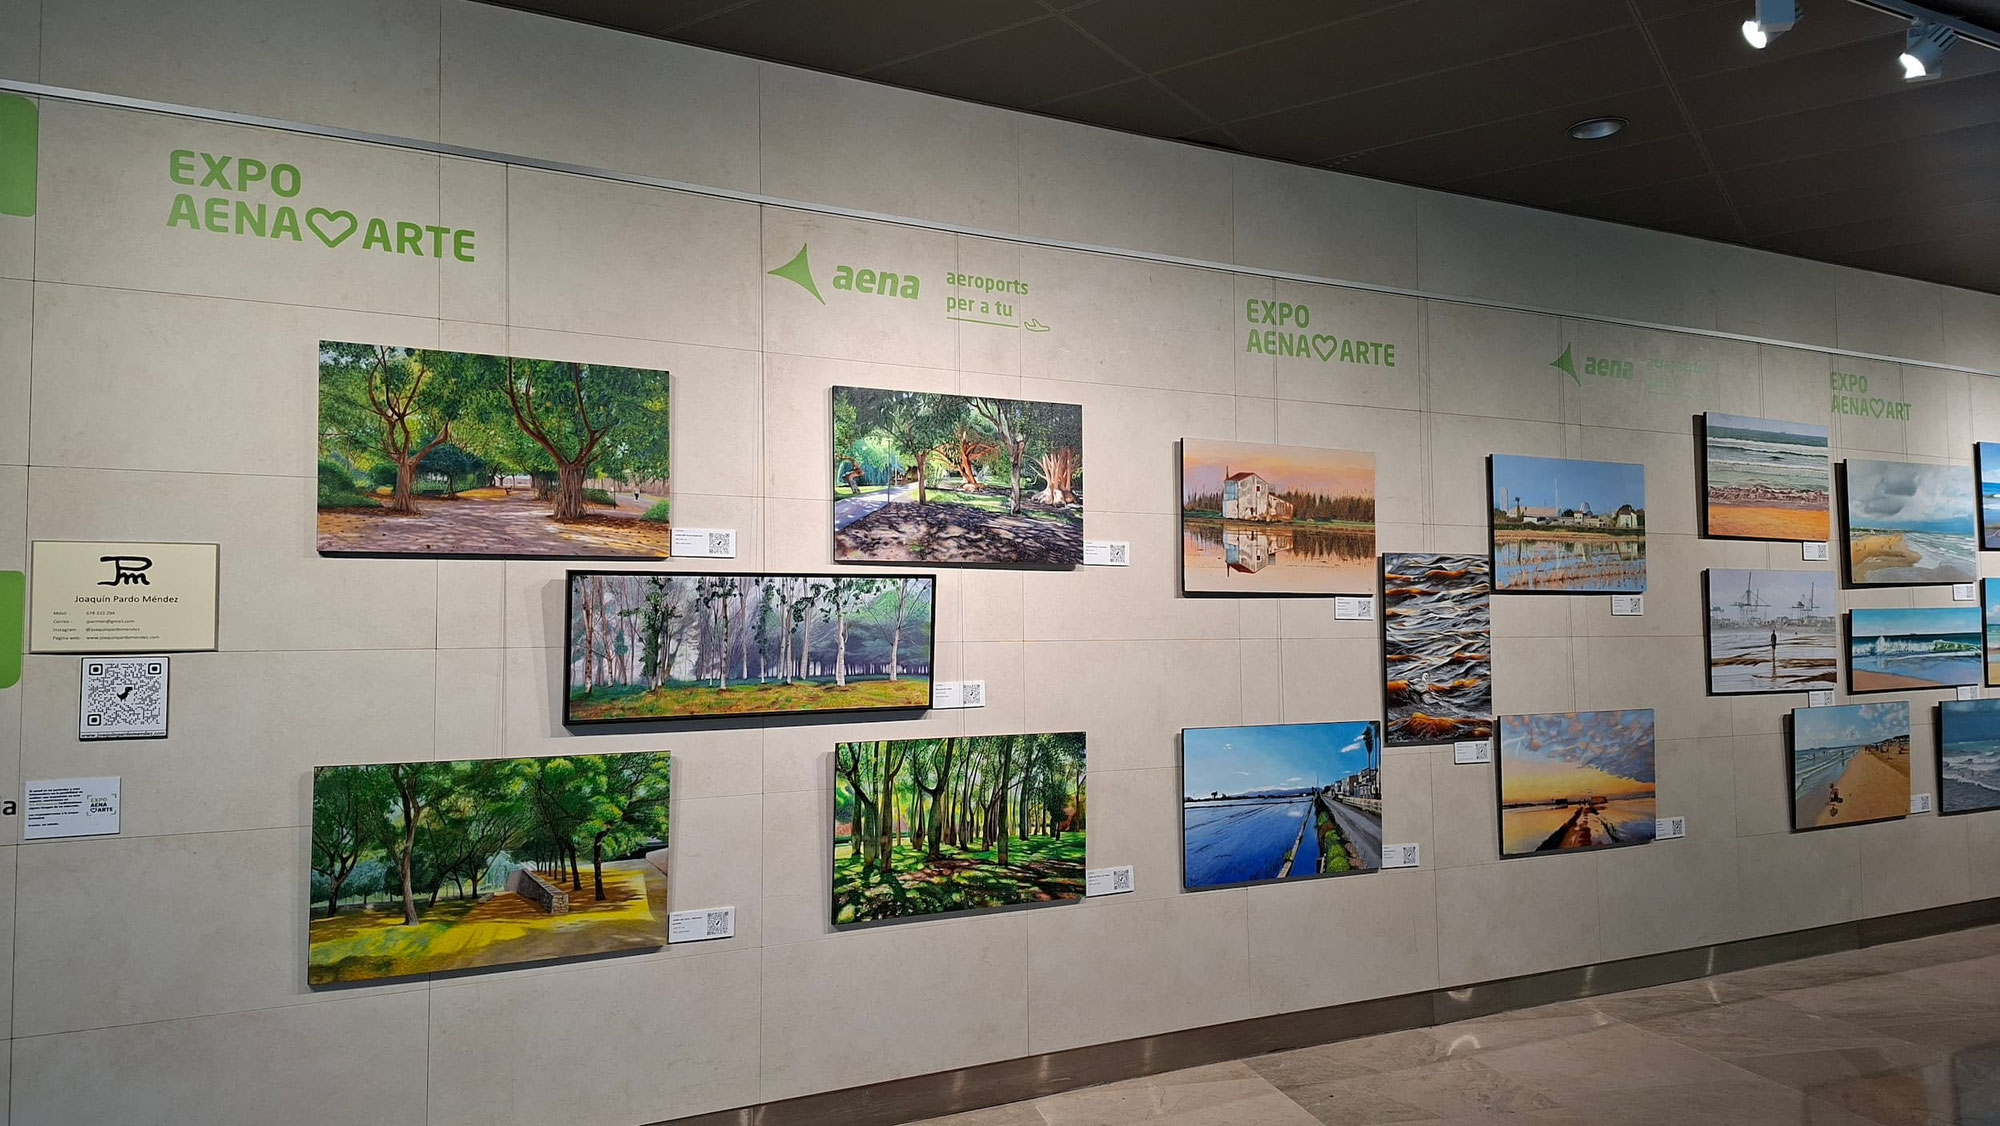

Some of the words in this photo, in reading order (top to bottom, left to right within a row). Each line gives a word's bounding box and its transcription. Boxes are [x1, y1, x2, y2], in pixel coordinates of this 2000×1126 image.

[169, 149, 302, 198] EXPO
[166, 193, 303, 242] AENA
[362, 218, 475, 263] ARTE
[832, 264, 921, 300] aena
[946, 270, 1029, 296] aeroports
[946, 296, 975, 313] per
[980, 302, 989, 315] a
[994, 300, 1013, 317] tu
[1246, 298, 1310, 328] EXPO
[1246, 329, 1311, 359] AENA
[1339, 339, 1395, 367] ARTE
[1584, 356, 1634, 380] aena
[1829, 371, 1868, 393] EXPO
[1831, 395, 1870, 417] AENA
[1886, 401, 1912, 421] ART
[74, 594, 111, 604] Joaquín
[113, 594, 140, 603] Pardo
[142, 594, 179, 603] Méndez
